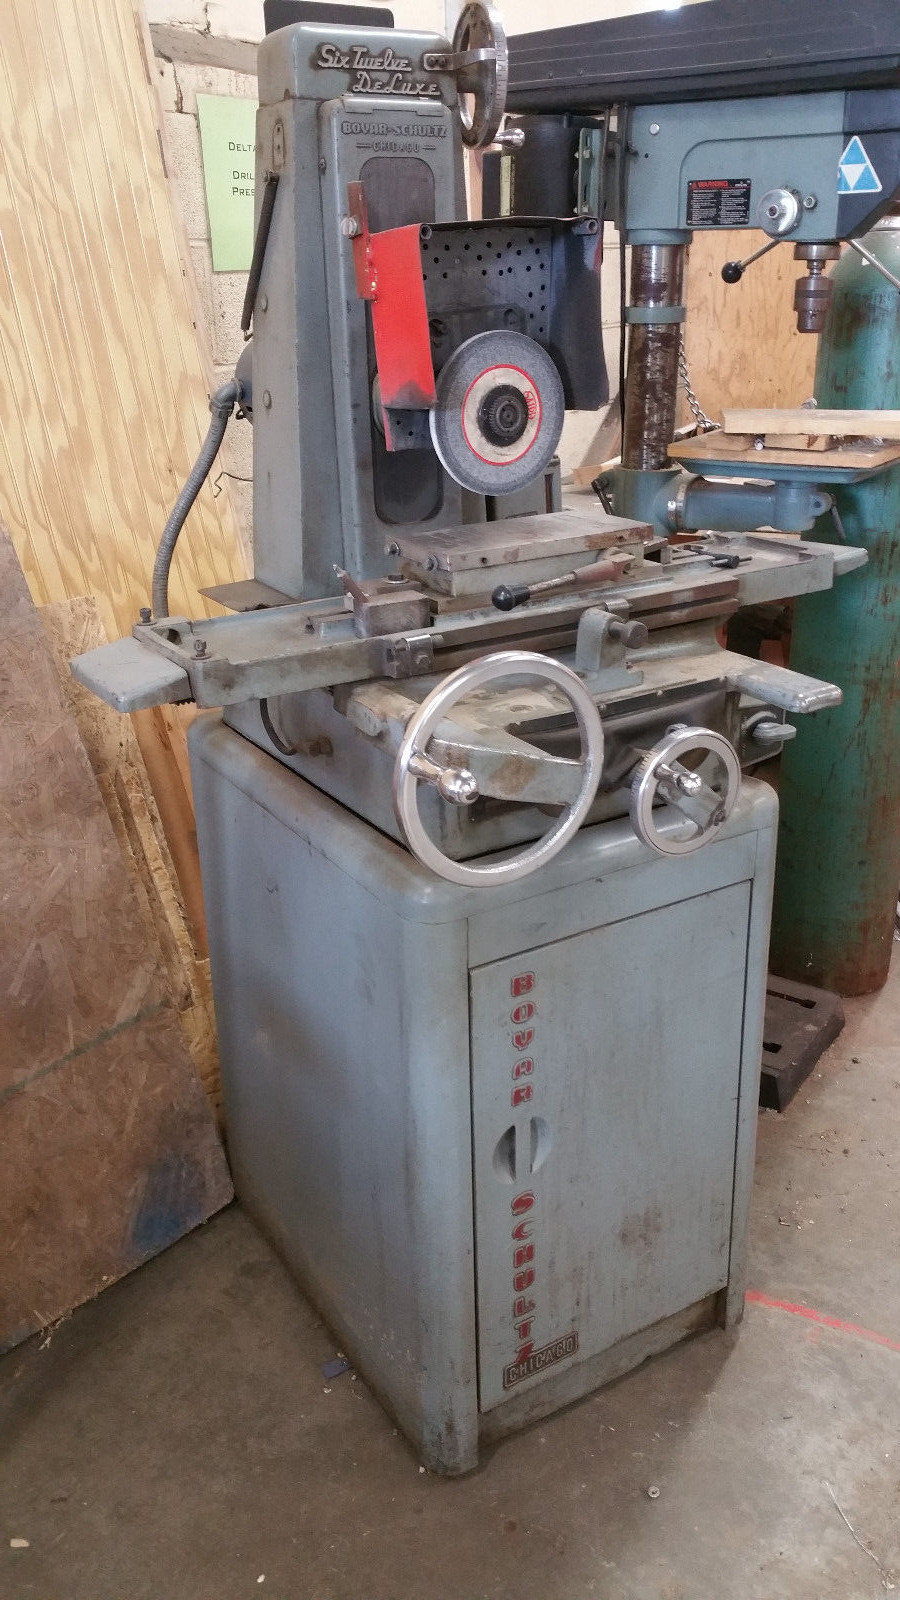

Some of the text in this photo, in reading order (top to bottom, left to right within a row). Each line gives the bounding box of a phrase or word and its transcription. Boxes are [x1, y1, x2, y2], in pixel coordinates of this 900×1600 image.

[317, 44, 412, 71] Six Twelve
[373, 141, 419, 153] CHICAGO
[511, 971, 537, 1364] BOYAR SCHULTZ
[509, 1337, 574, 1382] CHICAGO
